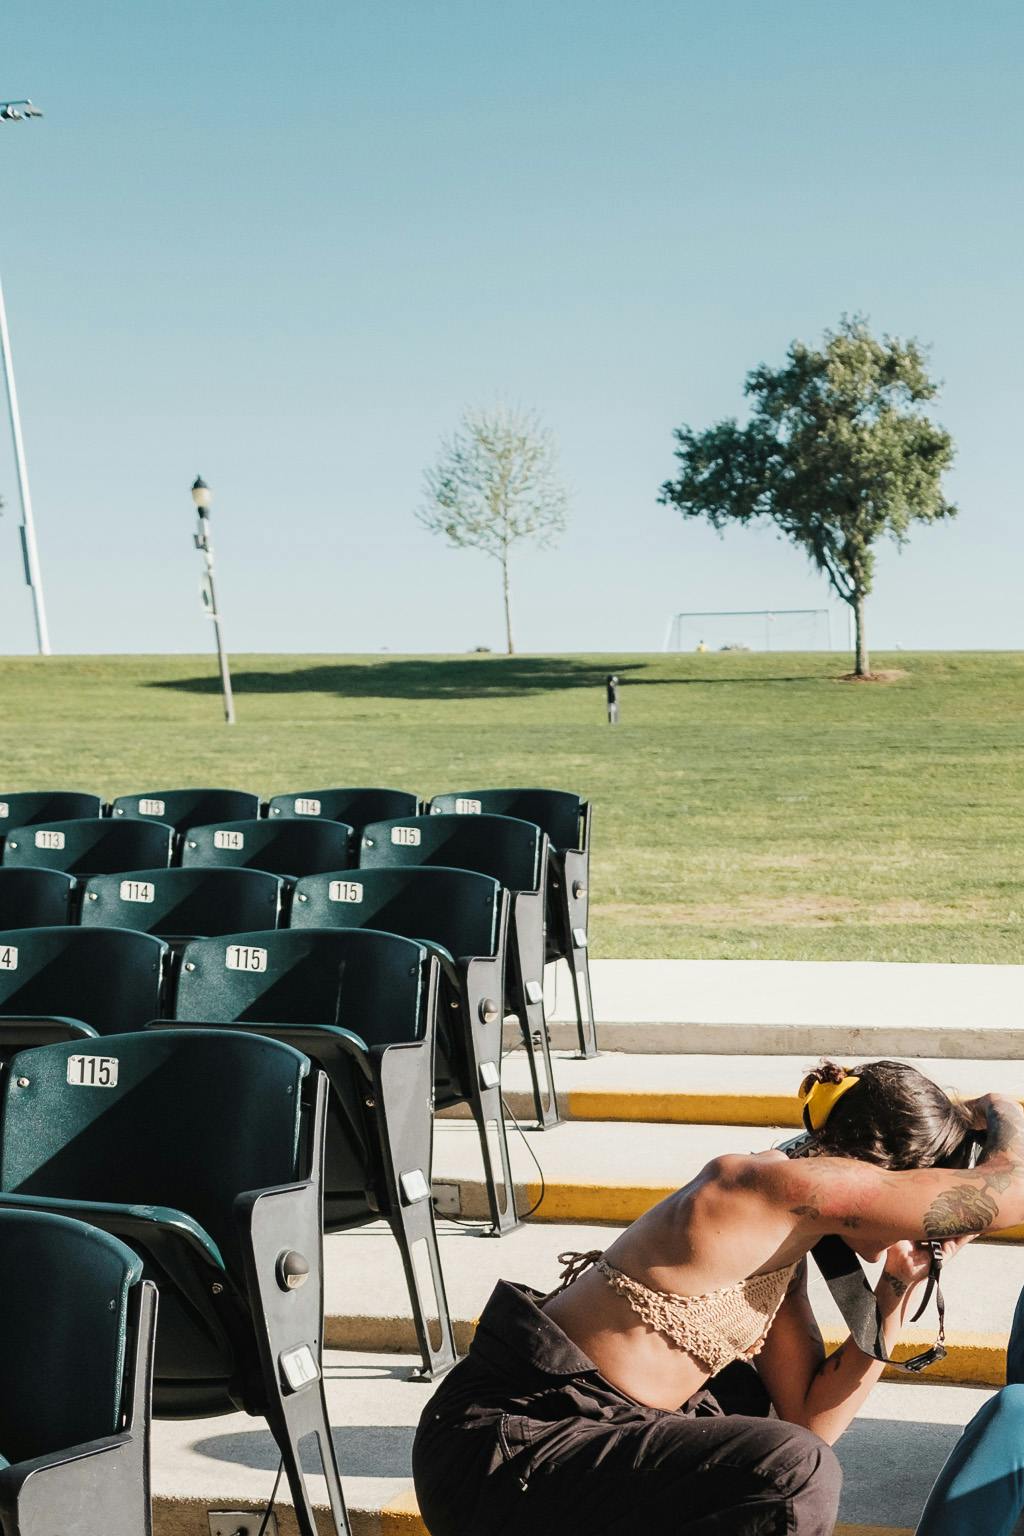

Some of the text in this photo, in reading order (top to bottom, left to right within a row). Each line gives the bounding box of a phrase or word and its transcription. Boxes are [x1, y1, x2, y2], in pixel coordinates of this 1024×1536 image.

[301, 800, 316, 813] 114
[42, 833, 60, 848] 113
[221, 833, 239, 847] 114
[398, 829, 416, 844] 115
[128, 883, 148, 900] 114
[336, 883, 357, 901] 115
[234, 948, 260, 969] 115
[77, 1057, 110, 1086] 115
